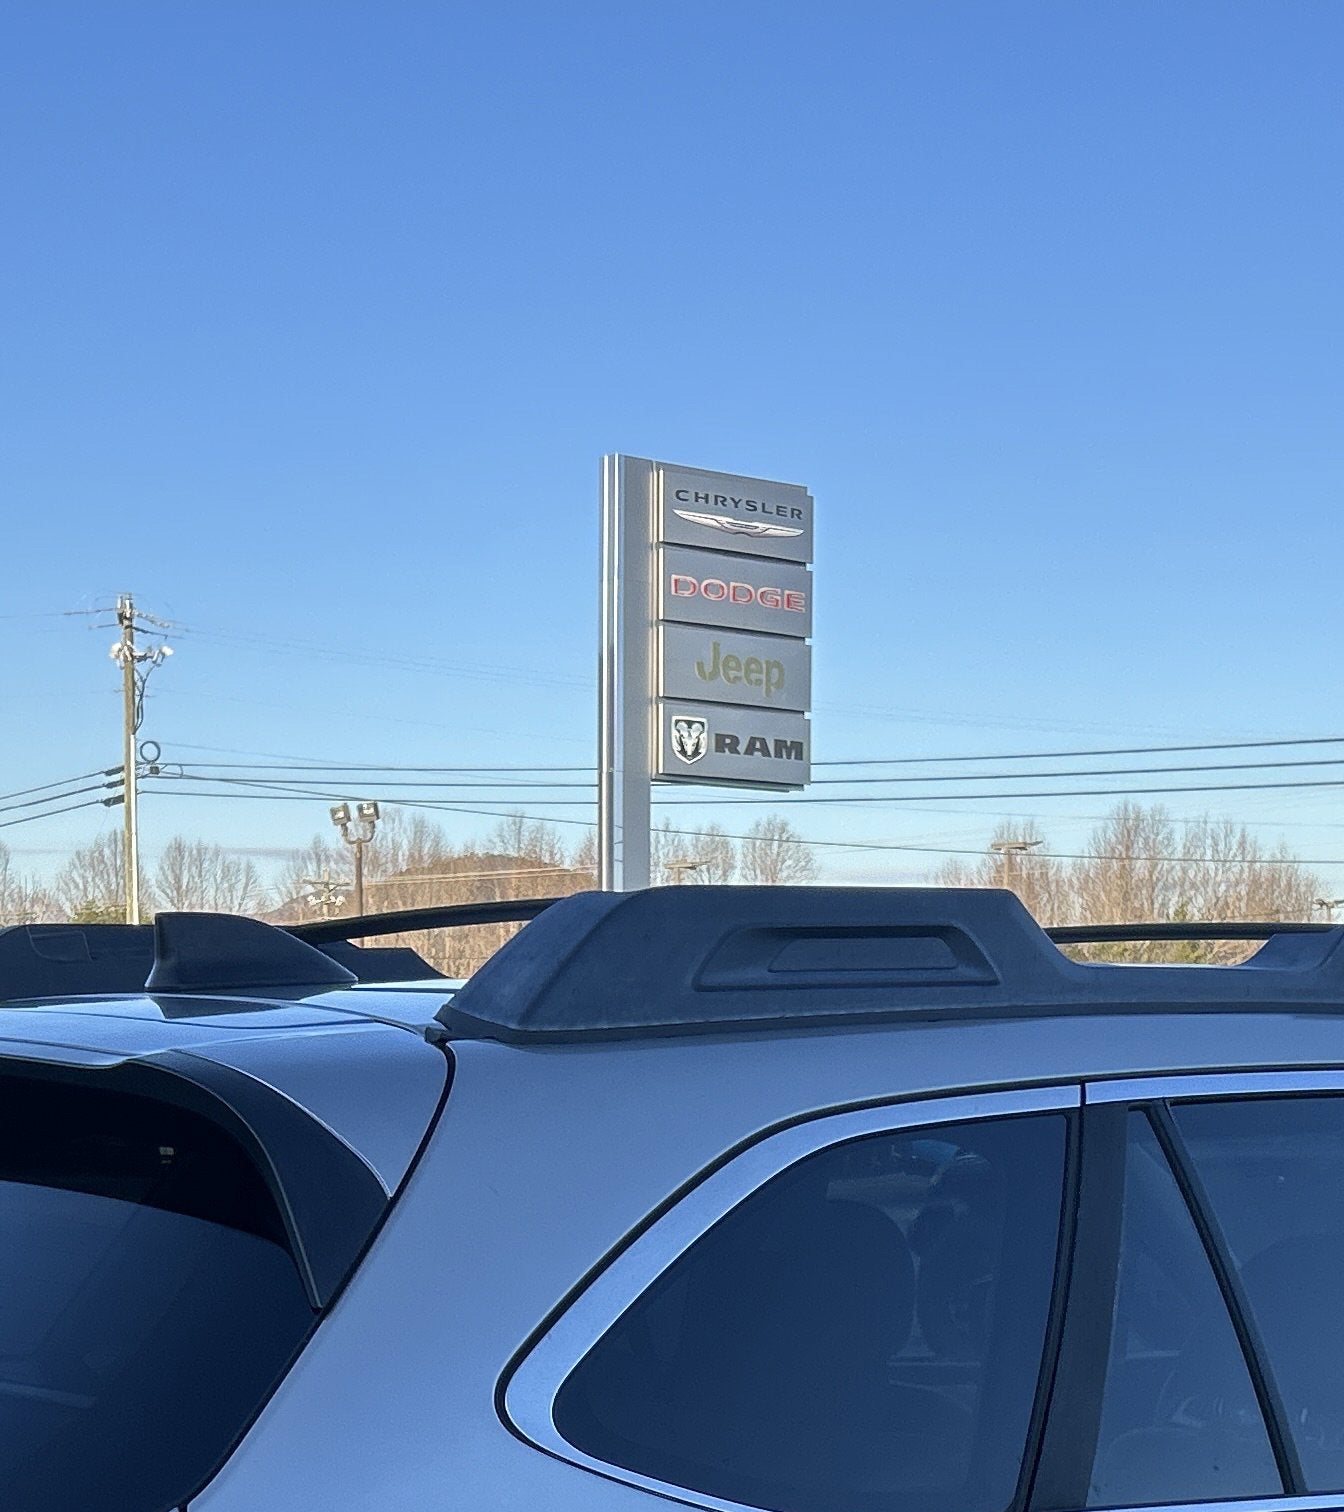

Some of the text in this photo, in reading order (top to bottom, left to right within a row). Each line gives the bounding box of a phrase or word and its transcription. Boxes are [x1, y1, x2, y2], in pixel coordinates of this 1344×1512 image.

[674, 488, 804, 521] CHRYSLER
[670, 573, 806, 613] DODGE
[694, 639, 786, 698] Jeep
[714, 733, 805, 761] RAM
